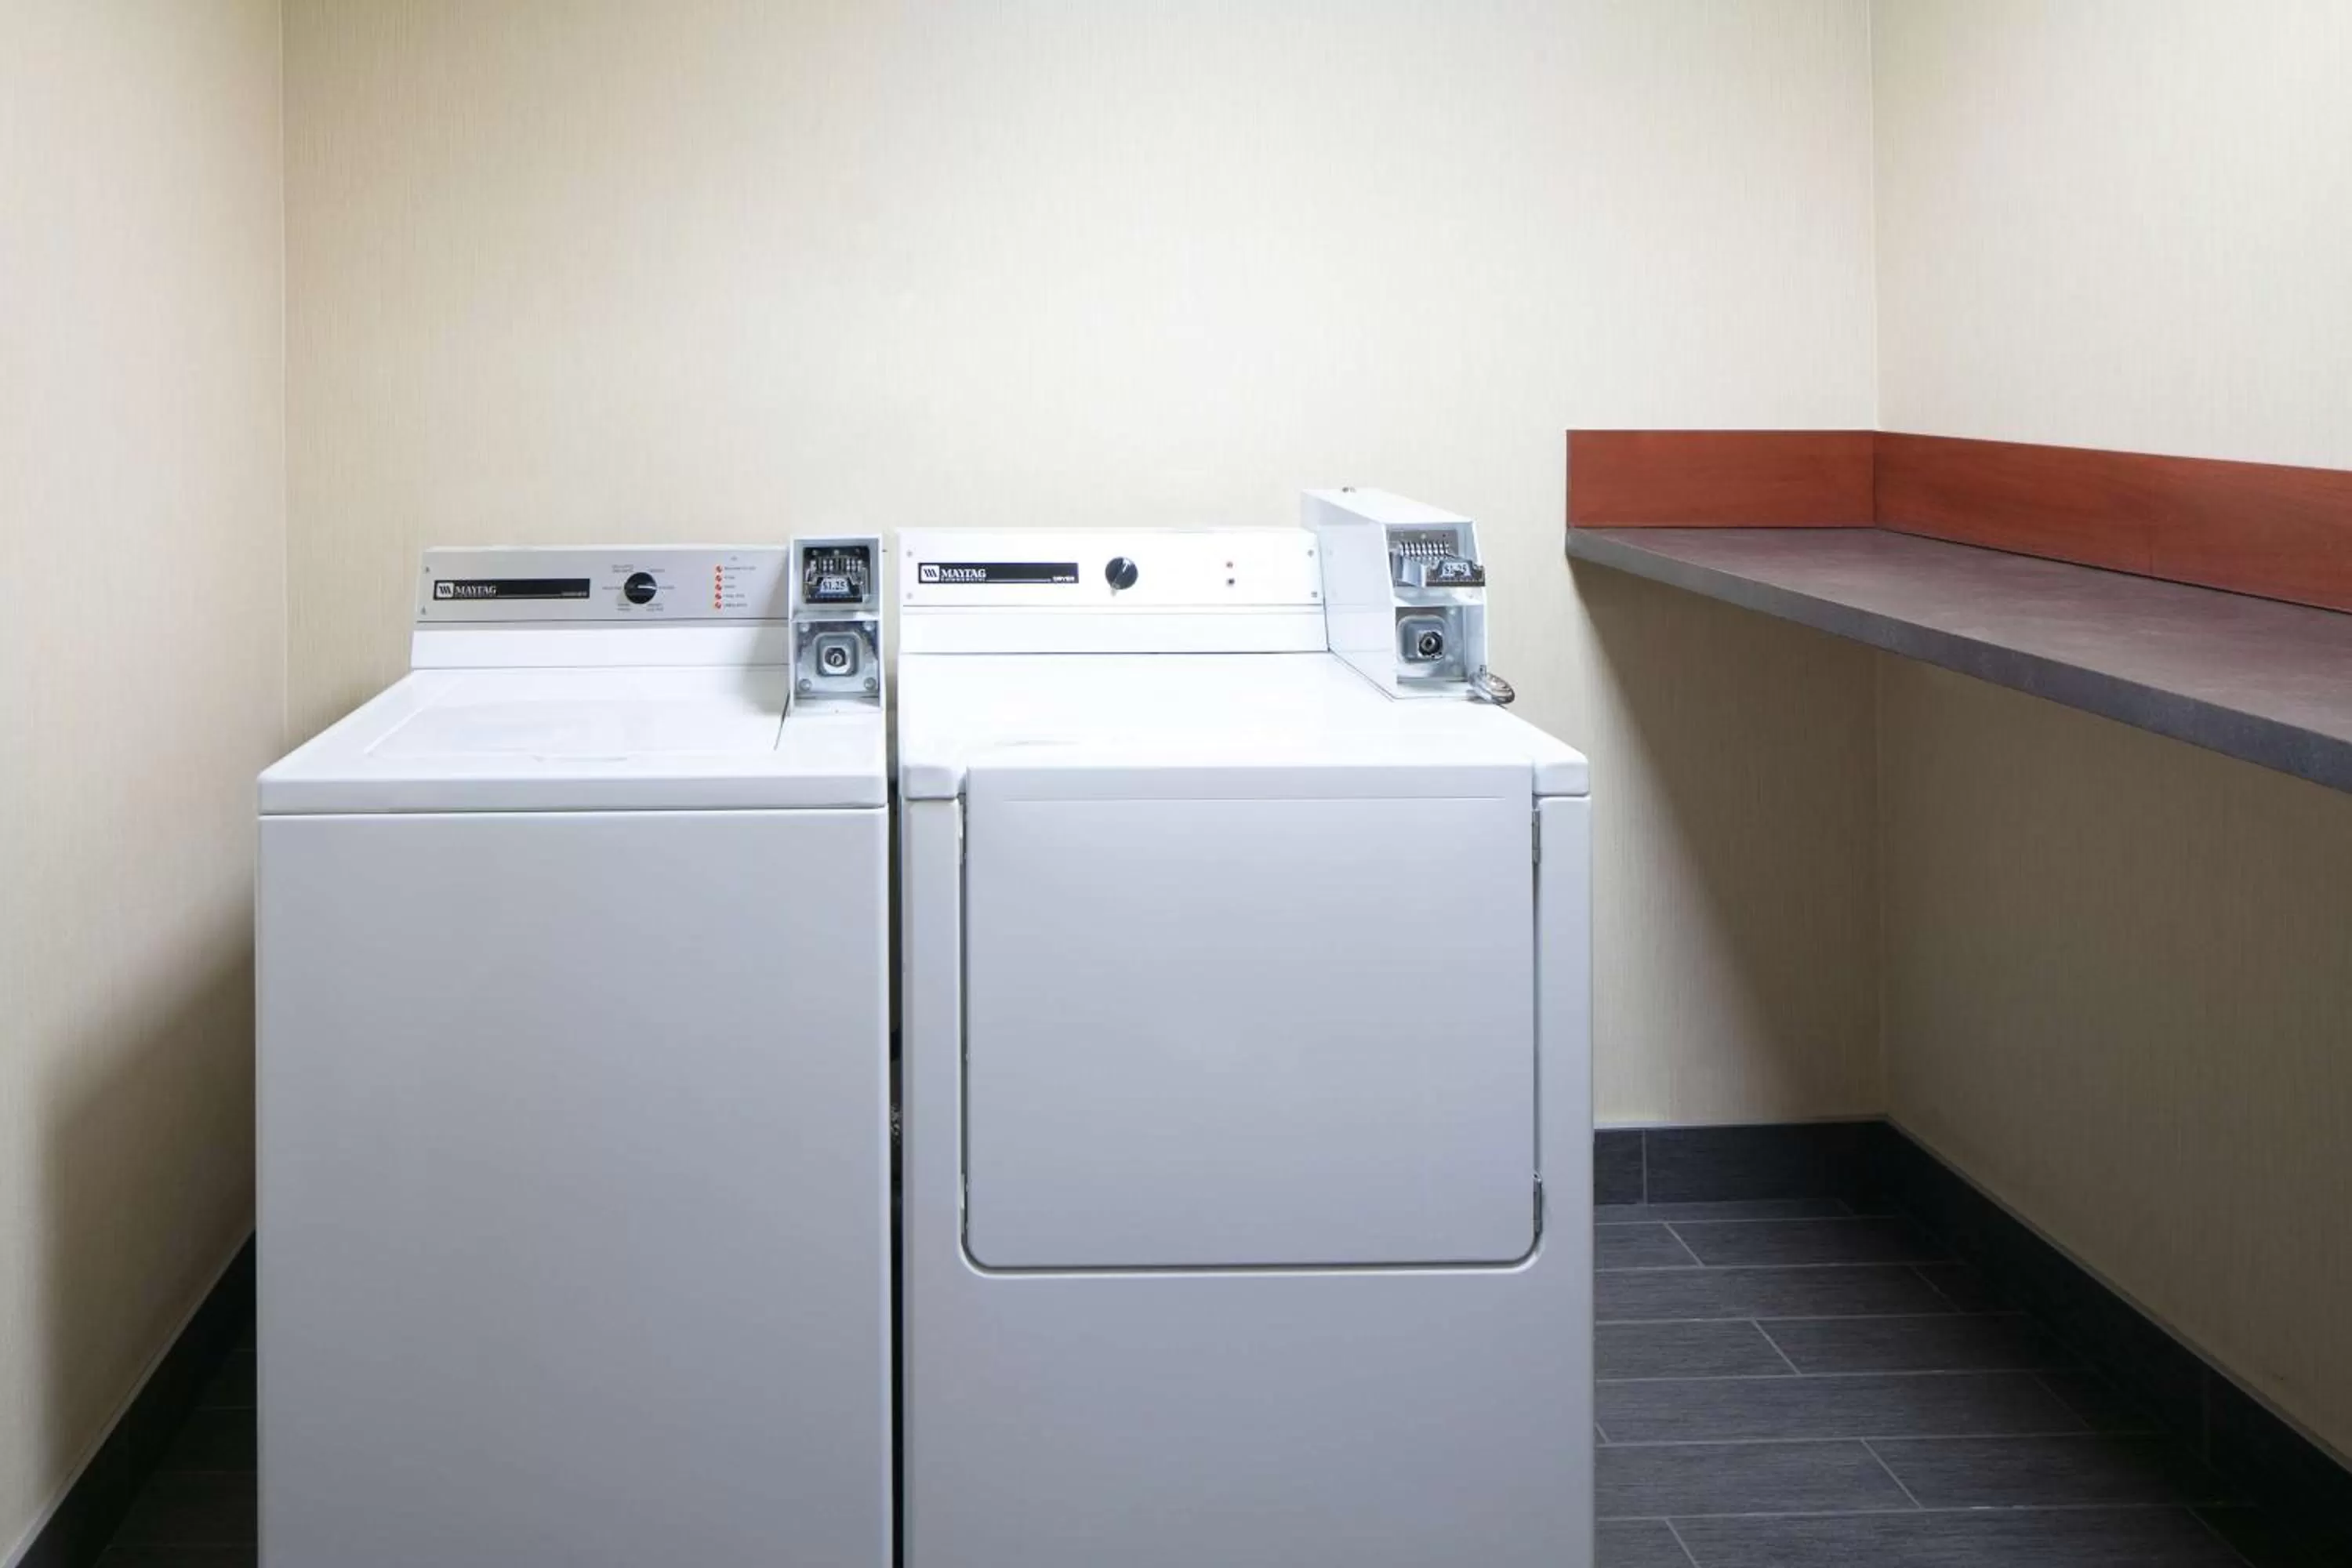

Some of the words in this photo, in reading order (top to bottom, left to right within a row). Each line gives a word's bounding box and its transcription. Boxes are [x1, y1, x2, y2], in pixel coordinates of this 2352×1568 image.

[1445, 564, 1467, 574] $125
[941, 569, 986, 578] MAYTAG
[455, 586, 496, 594] MAYTAG
[823, 582, 844, 590] $1.25
